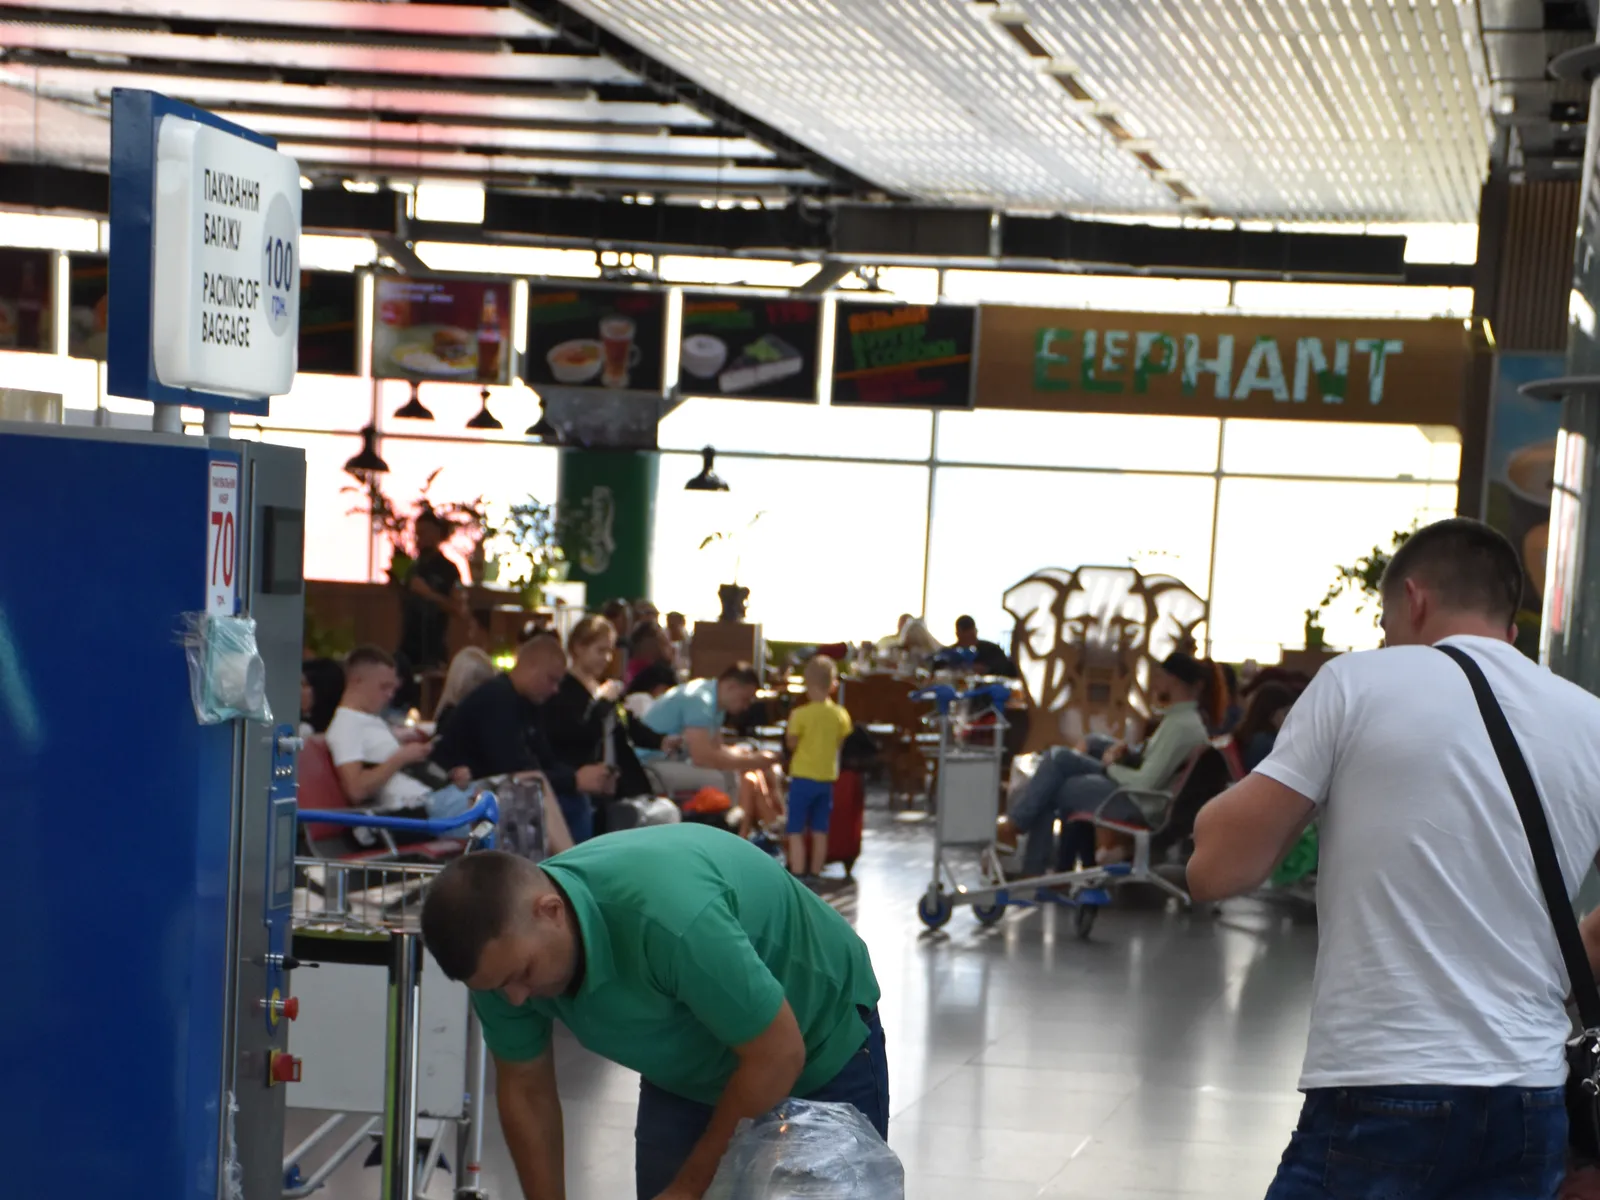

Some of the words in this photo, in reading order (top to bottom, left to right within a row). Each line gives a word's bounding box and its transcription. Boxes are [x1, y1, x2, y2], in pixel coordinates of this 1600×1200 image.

[204, 169, 260, 211] ПАКУВАННЯ
[204, 213, 240, 250] БАГАЖУ
[265, 236, 292, 291] 100
[203, 272, 244, 308] PACKING
[245, 279, 260, 309] OF
[202, 312, 250, 347] BAGGAGE
[1032, 324, 1405, 405] ELEPHANT
[211, 511, 234, 586] 70
